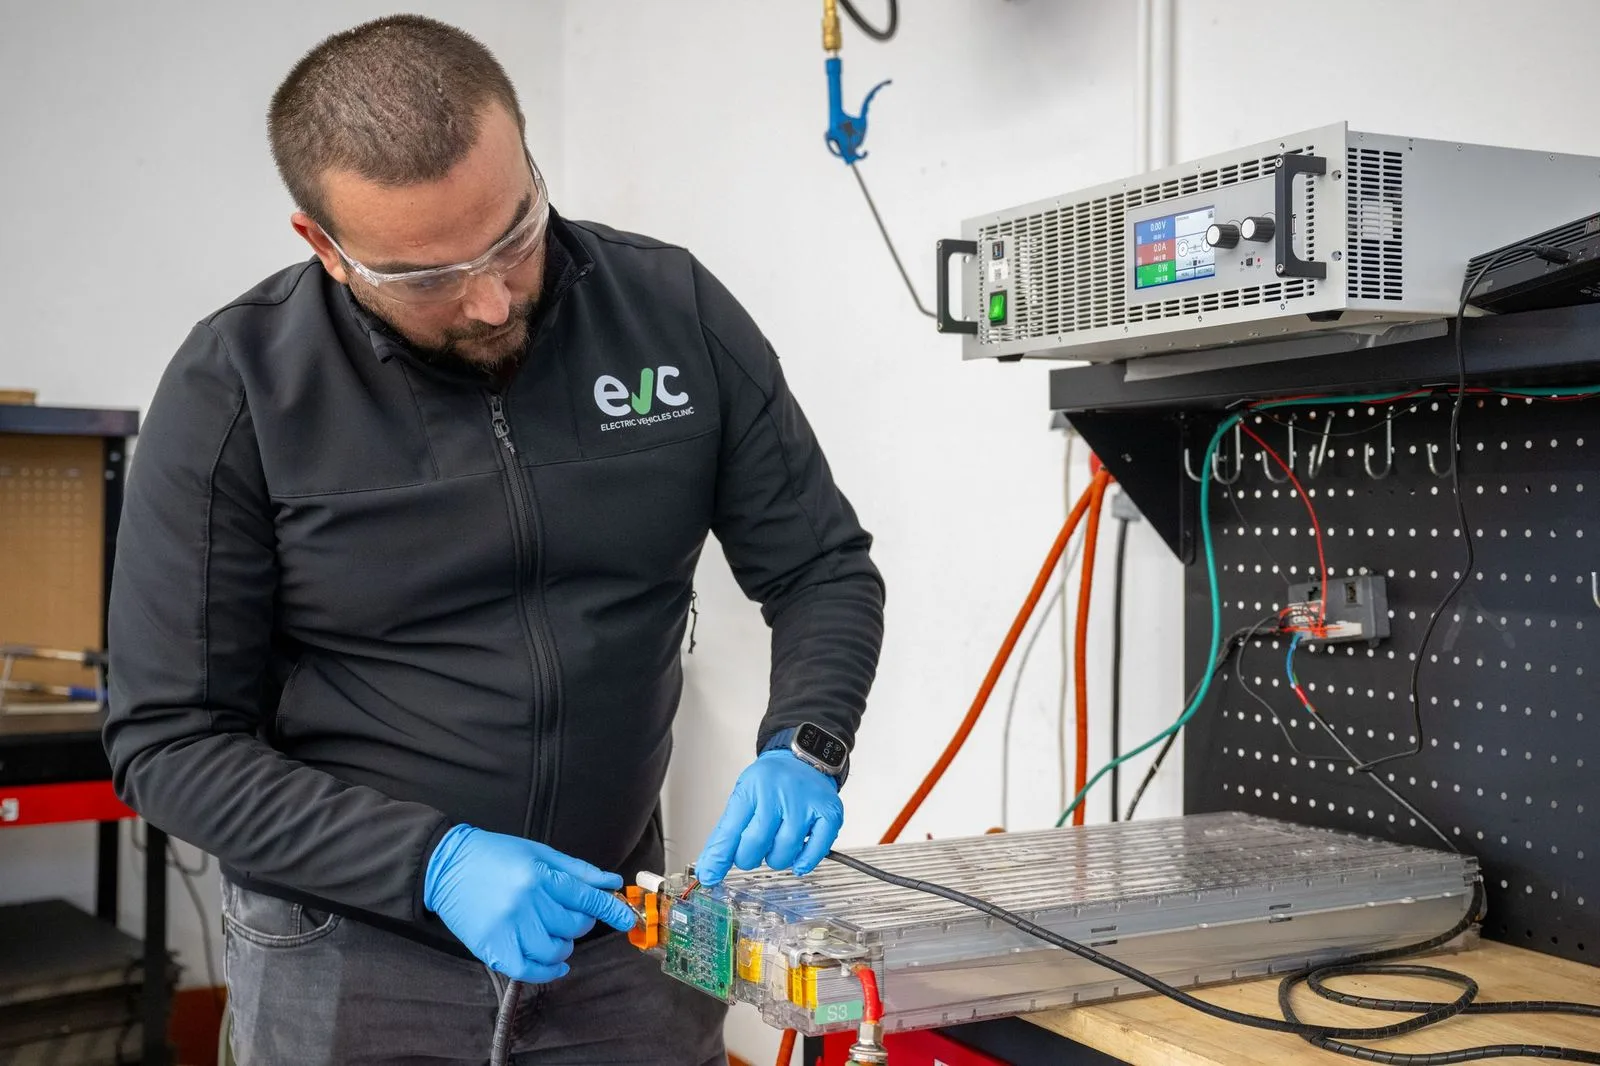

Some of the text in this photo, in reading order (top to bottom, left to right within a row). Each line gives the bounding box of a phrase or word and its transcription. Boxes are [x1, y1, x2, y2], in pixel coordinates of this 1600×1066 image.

[600, 406, 695, 432] ELECTRIC VEHICLES CLINIC
[827, 1003, 848, 1021] S3
